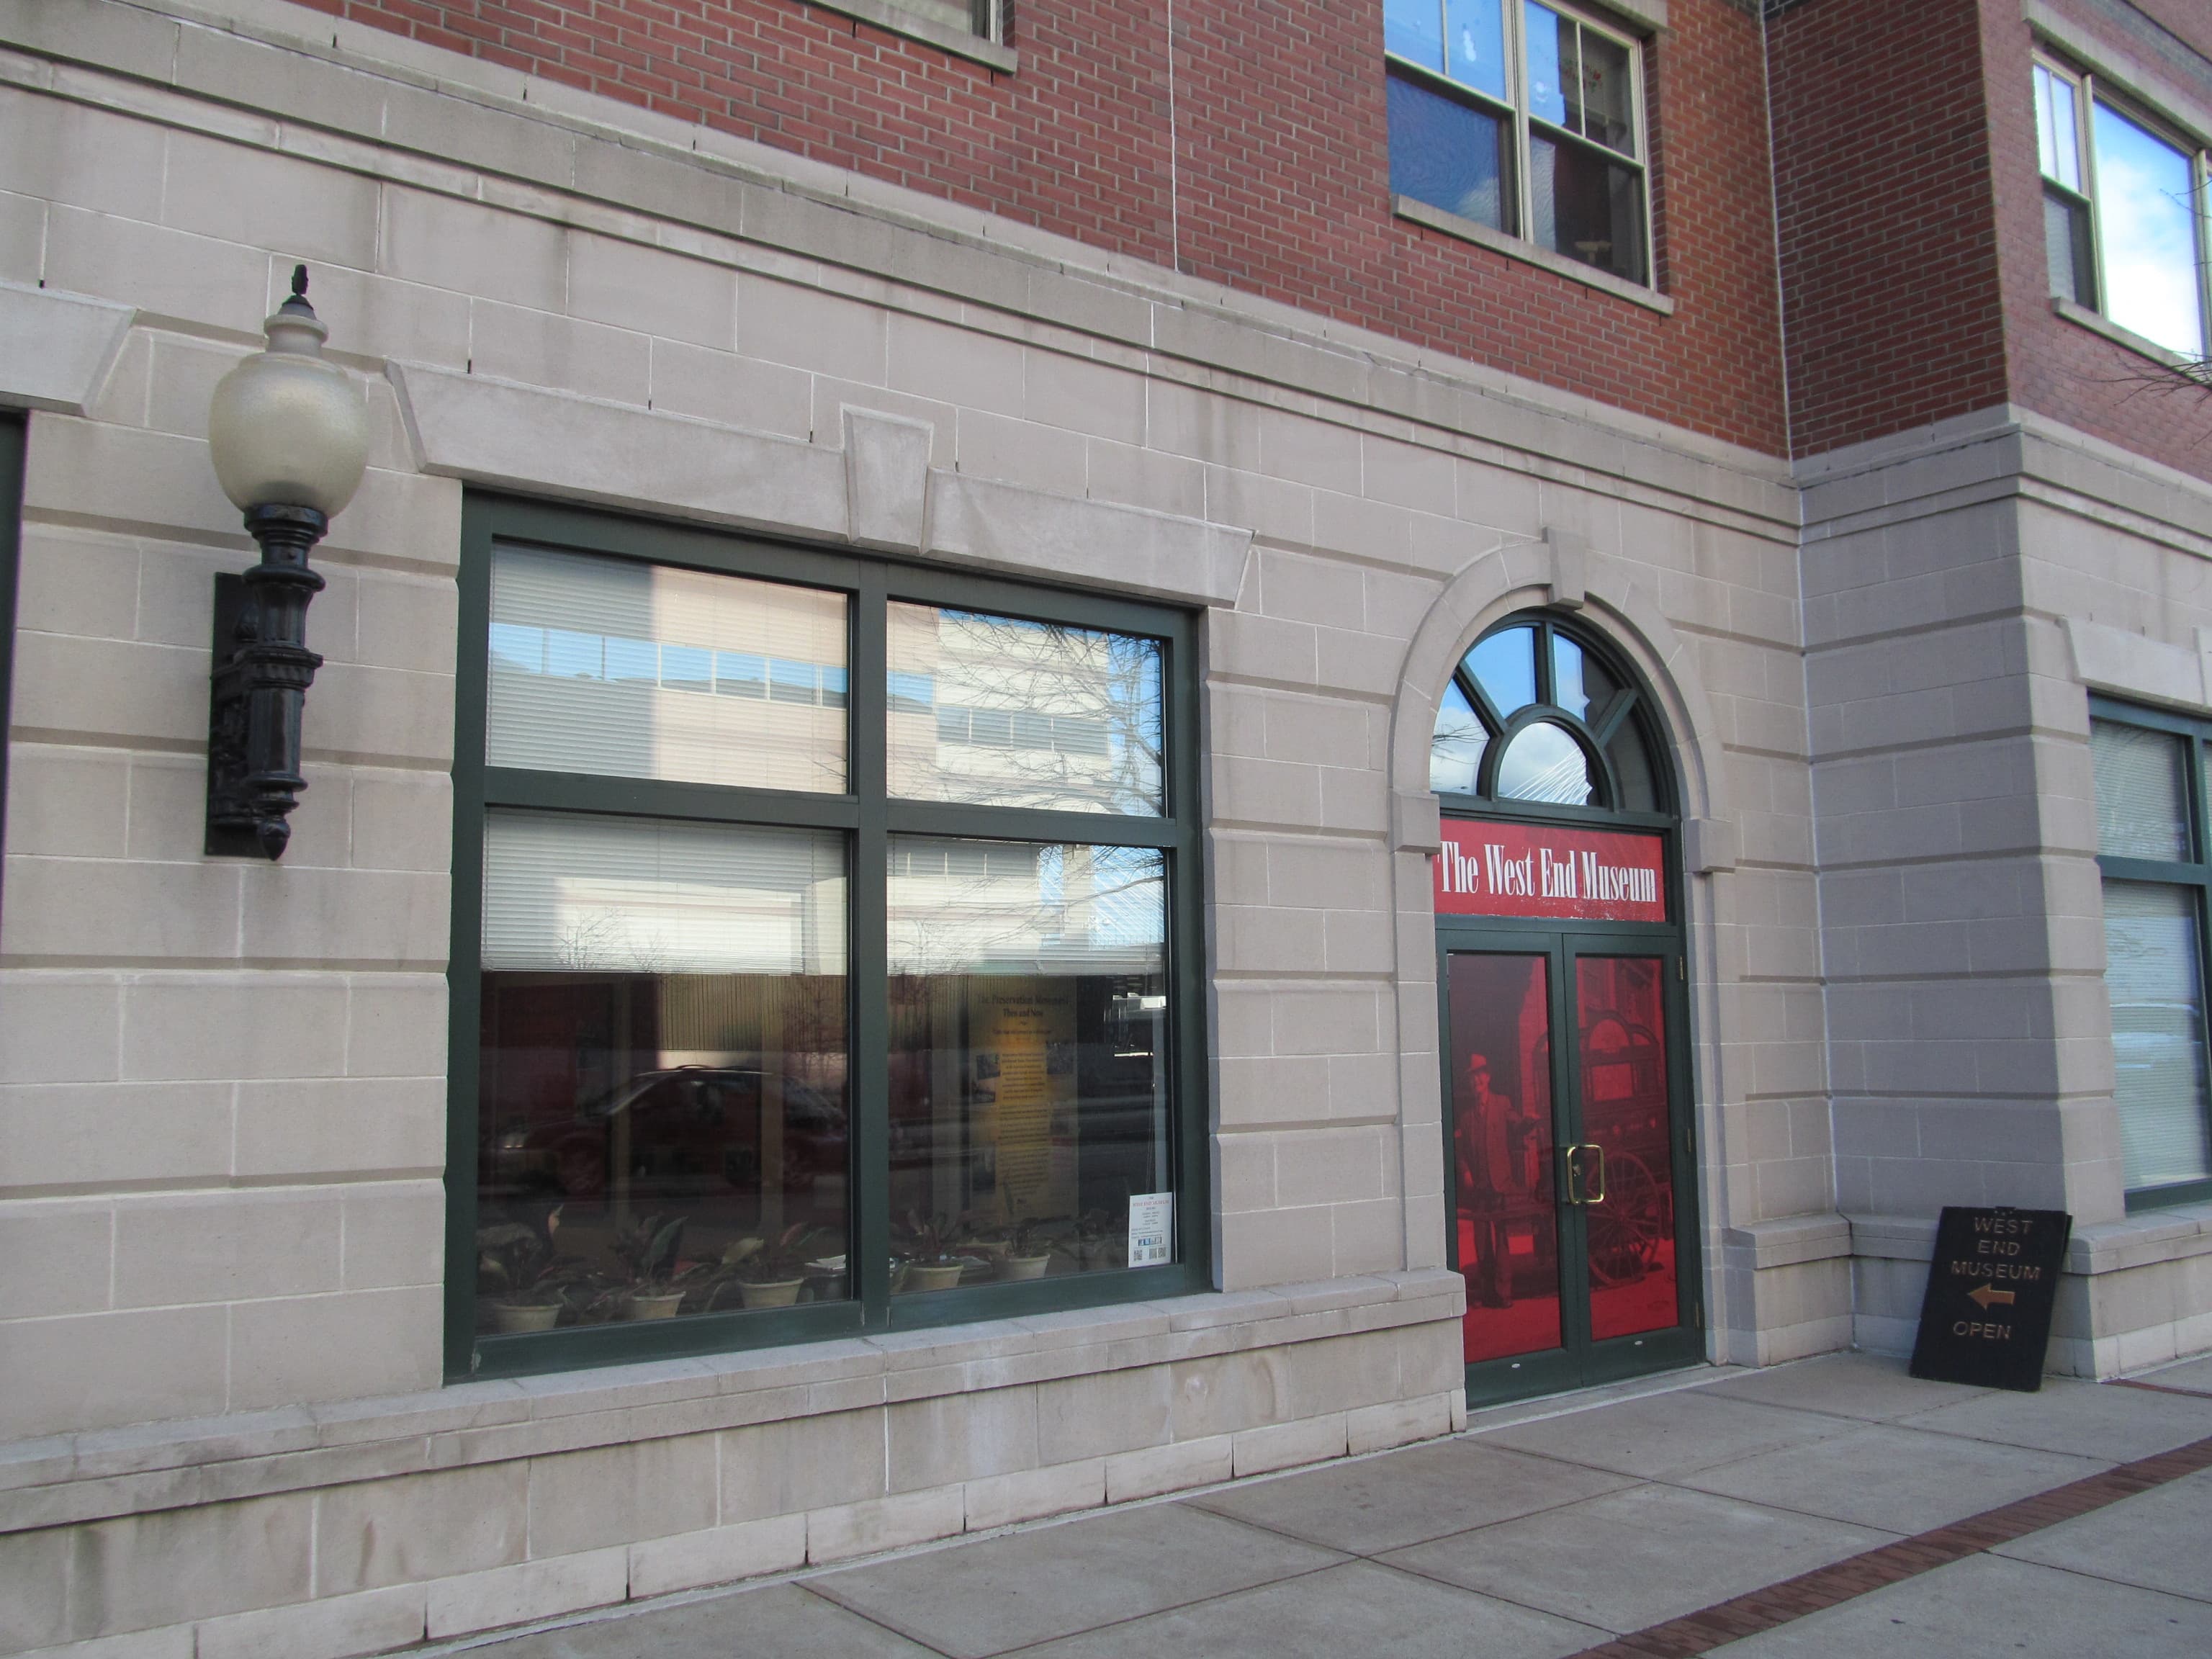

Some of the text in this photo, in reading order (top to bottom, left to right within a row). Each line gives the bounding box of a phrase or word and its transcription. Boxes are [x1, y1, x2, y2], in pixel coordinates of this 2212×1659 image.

[1436, 841, 1656, 902] The West End Museum
[1974, 1217, 2033, 1234] WEST
[1977, 1240, 2020, 1256] END
[1951, 1261, 2041, 1280] MUSEUM
[1953, 1321, 2011, 1339] OPEN
